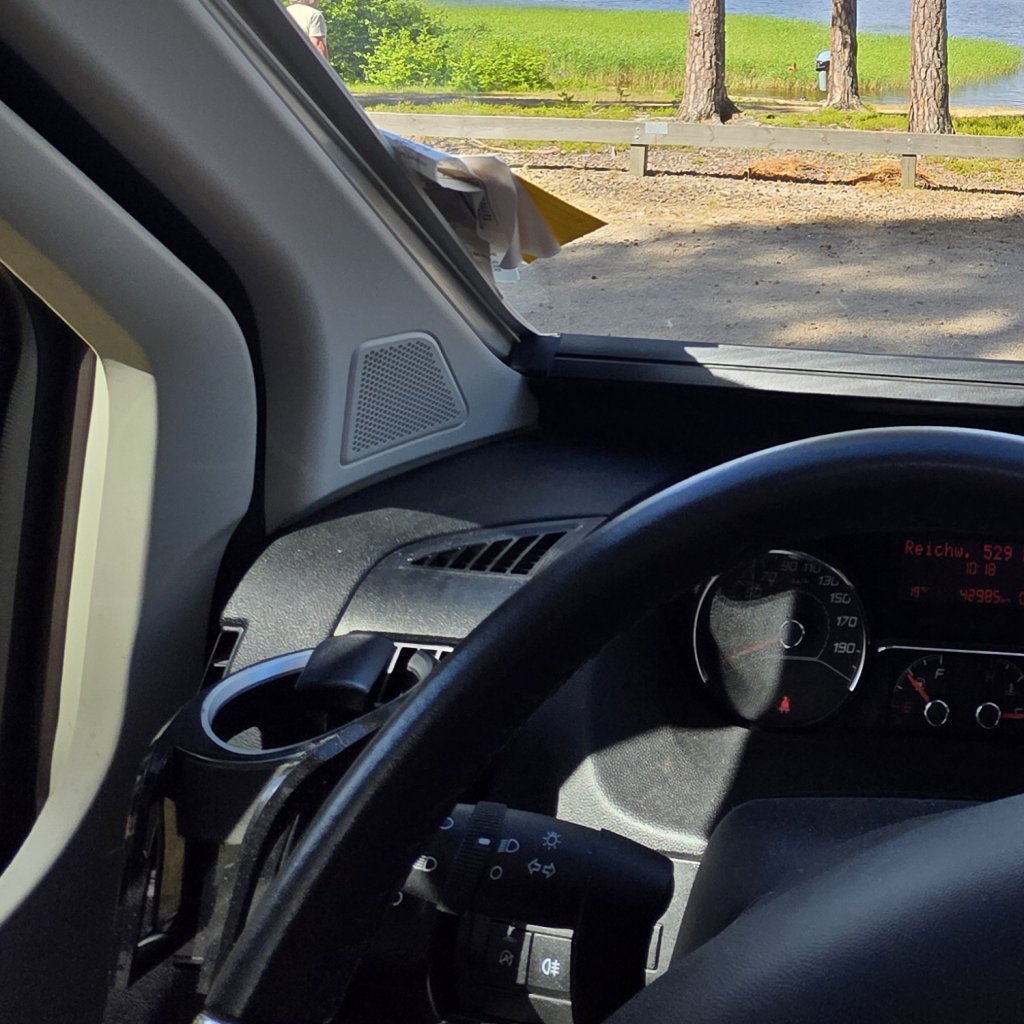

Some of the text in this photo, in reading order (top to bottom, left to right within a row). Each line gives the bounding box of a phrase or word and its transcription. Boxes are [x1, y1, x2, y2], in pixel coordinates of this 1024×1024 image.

[904, 539, 970, 559] Reichw.
[983, 543, 1013, 561] 529
[818, 575, 839, 587] 130
[829, 592, 851, 604] 150
[836, 616, 858, 628] 170
[833, 642, 856, 654] 190
[934, 668, 945, 680] F
